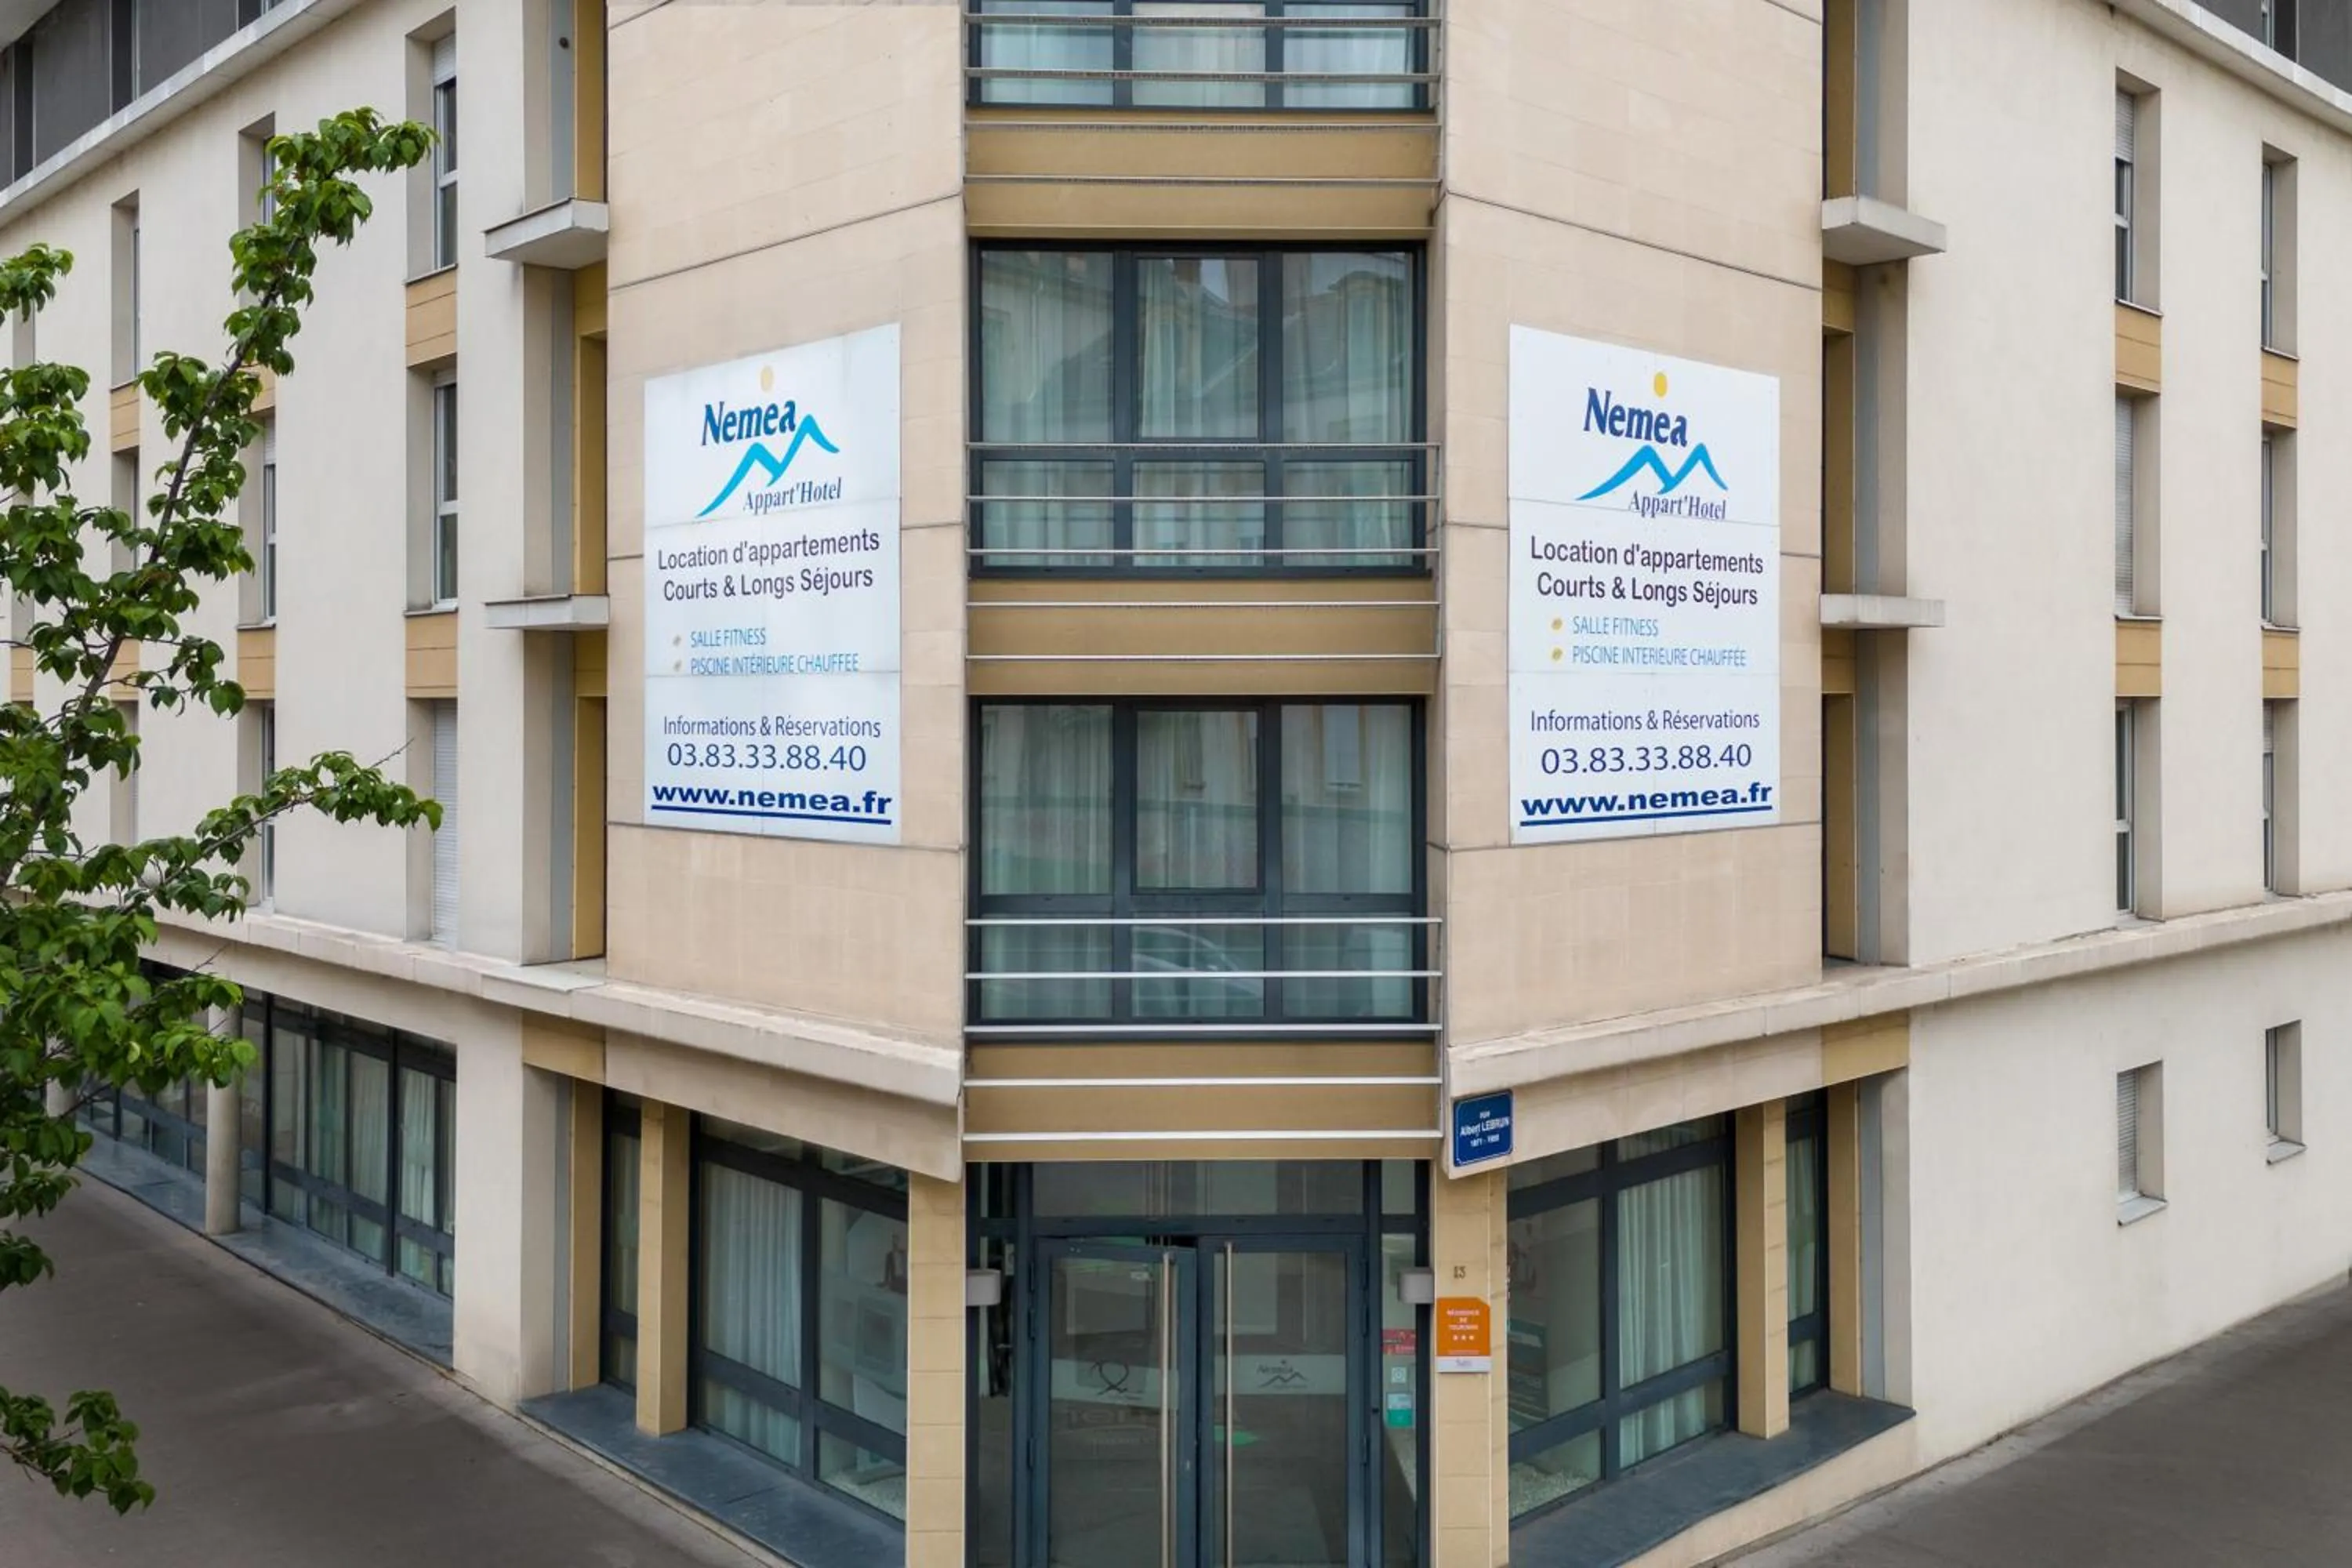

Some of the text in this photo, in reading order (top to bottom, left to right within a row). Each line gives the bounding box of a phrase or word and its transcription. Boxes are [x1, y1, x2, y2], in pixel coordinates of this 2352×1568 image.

[701, 400, 796, 446] Nemea
[1583, 387, 1688, 447] Nemea
[743, 477, 841, 515] Appart'Hotel
[1628, 490, 1726, 520] Appart'Hotel
[658, 528, 880, 570] Location d'appartements
[1531, 535, 1764, 574] Location d'appartements
[664, 566, 873, 601] Courts & Longs Séjours
[1537, 572, 1758, 609] Courts & Longs Séjours
[691, 627, 766, 648] SALLE FITNESS
[1573, 615, 1658, 637] SALLE FITNESS
[691, 656, 730, 675] PISCINE
[1573, 645, 1619, 664] PISCINE
[664, 714, 881, 738] Informations & Réservations
[1531, 709, 1760, 731] Informations & Réservations
[667, 742, 866, 771] 03.83.33.88.40
[1541, 744, 1752, 774] 03.83.33.88.40
[652, 786, 892, 815] www.nemea.fr
[1521, 782, 1773, 816] www.nemea.fr
